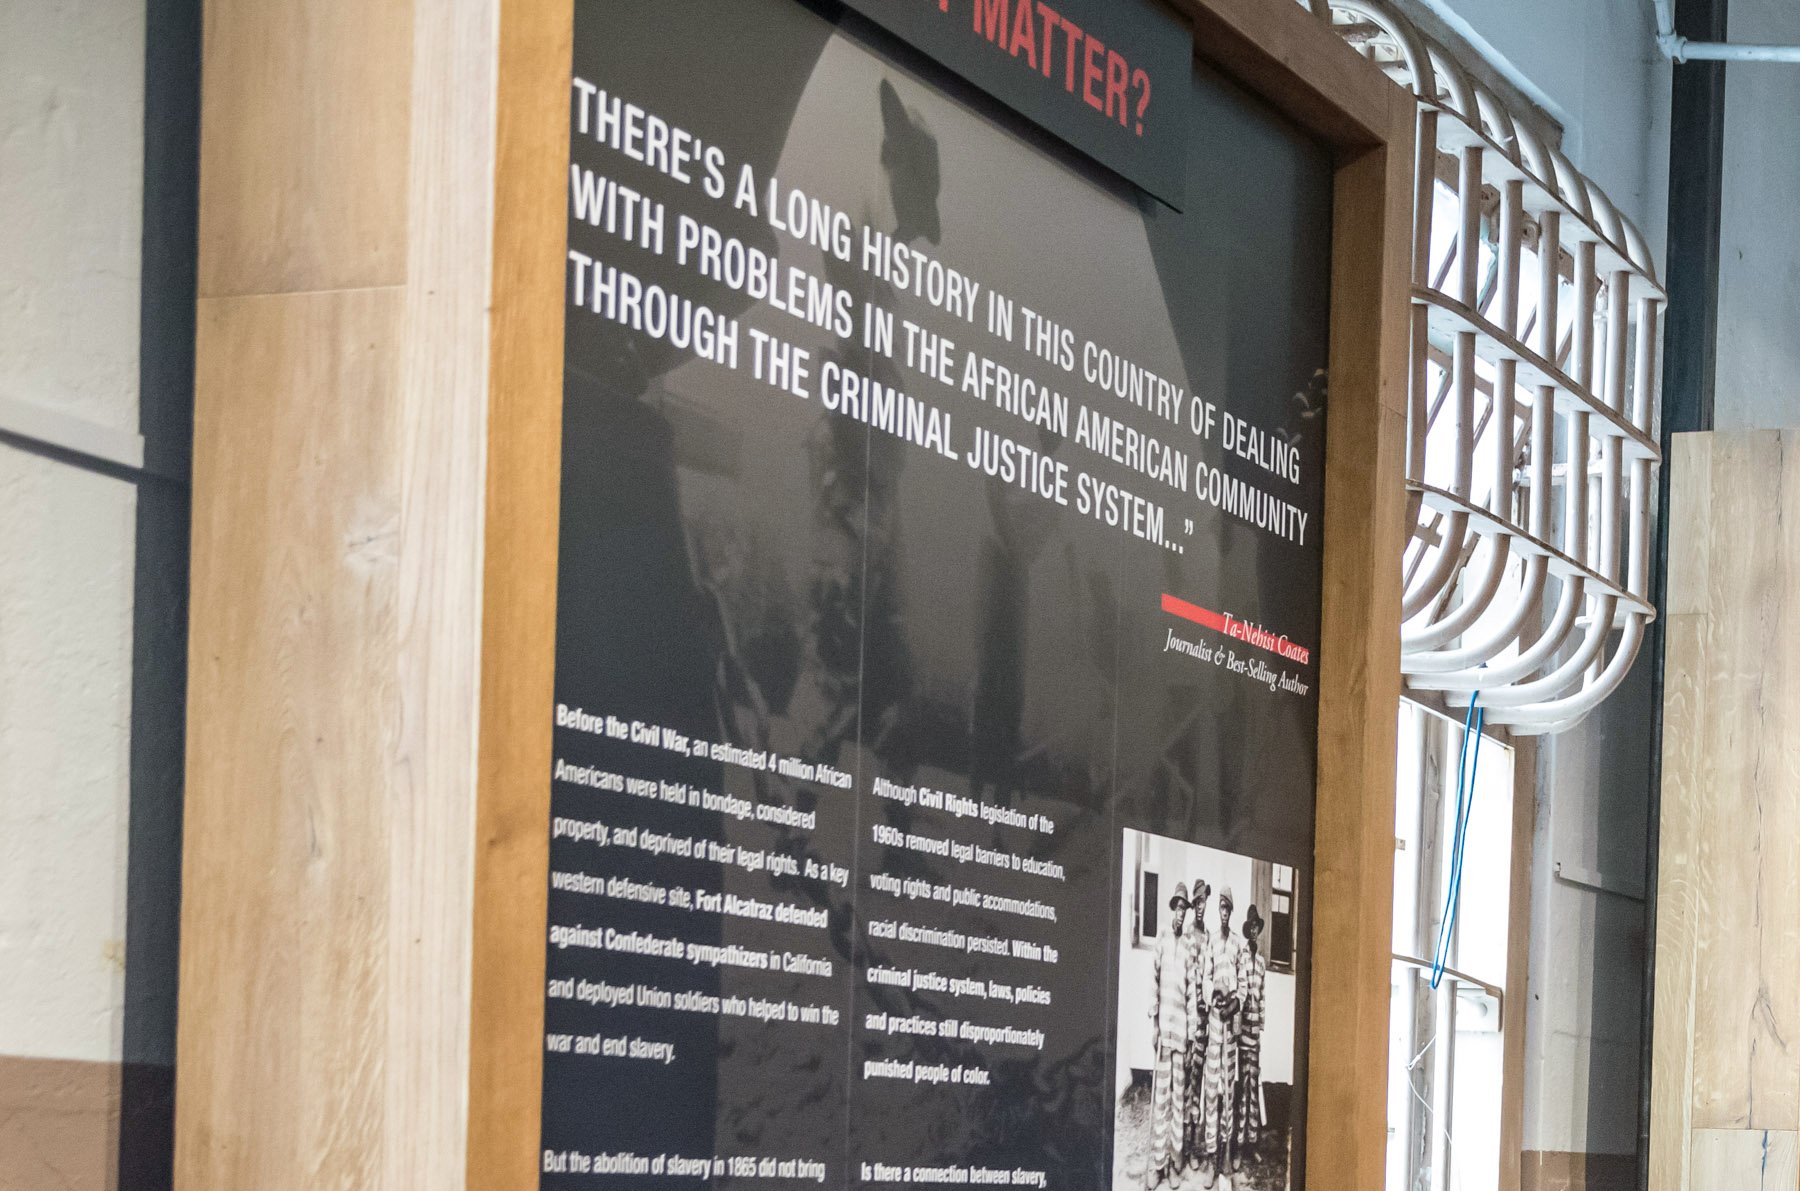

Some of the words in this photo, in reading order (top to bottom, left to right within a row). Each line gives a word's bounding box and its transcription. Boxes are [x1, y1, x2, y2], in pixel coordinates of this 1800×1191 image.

[973, 0, 1151, 136] MATTER?
[573, 79, 724, 197] THERE'S
[735, 164, 757, 216] A
[769, 179, 850, 260] LONG
[863, 227, 979, 320] HISTORY
[988, 291, 1013, 341] IN
[1022, 308, 1074, 370] THIS
[1084, 342, 1184, 423] COUNTRY
[1190, 397, 1216, 439] OF
[1223, 413, 1299, 483] DEALING
[569, 252, 738, 366] THROUGH
[749, 329, 810, 398] THE
[821, 363, 958, 458] CRIMINAL
[967, 428, 1068, 504] JUSTICE
[572, 166, 664, 253] WITH
[678, 217, 852, 336] PROBLEMS
[864, 303, 893, 357] IN
[903, 321, 954, 385] THE
[962, 353, 1068, 435] AFRICAN
[1075, 407, 1187, 490] AMERICAN
[1196, 463, 1307, 543] COMMUNITY
[1164, 628, 1212, 662] Journalist
[1214, 645, 1225, 665] &
[1226, 651, 1277, 691] Best-Selling
[1278, 671, 1308, 696] Author
[1223, 612, 1275, 651] Ta-Nehisi
[1278, 635, 1309, 664] Coates
[557, 704, 603, 734] Before
[606, 716, 628, 739] the
[630, 721, 660, 746] Civil
[662, 728, 690, 756] War,
[693, 740, 708, 757] an
[710, 743, 766, 769] estimated
[768, 753, 776, 772] 4
[778, 758, 814, 780] million
[815, 764, 852, 788] African
[547, 1034, 573, 1052] war
[575, 1035, 600, 1054] and
[602, 1037, 627, 1056] end
[629, 1038, 675, 1063] slavery.
